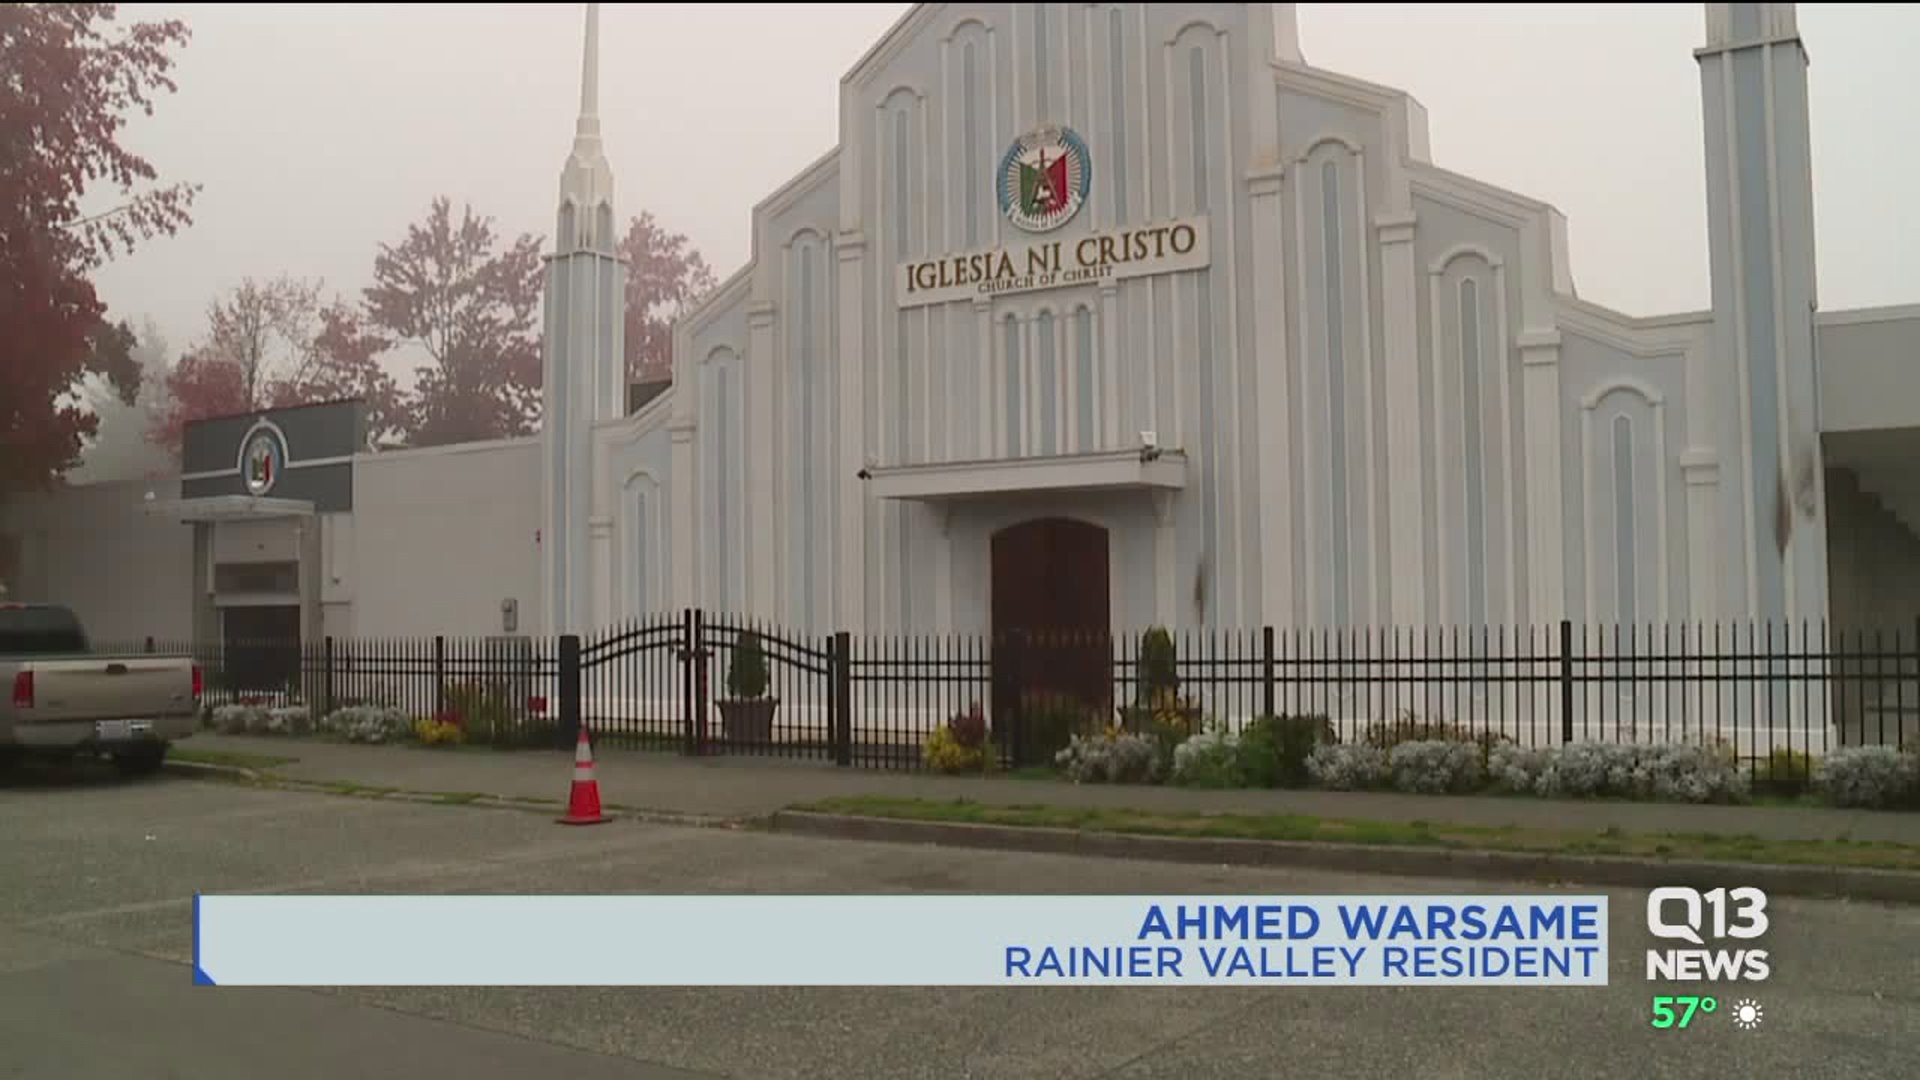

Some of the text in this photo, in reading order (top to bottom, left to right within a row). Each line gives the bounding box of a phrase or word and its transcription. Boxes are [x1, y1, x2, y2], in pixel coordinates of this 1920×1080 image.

[906, 224, 1197, 293] IGLESIA NI CRISTO
[977, 265, 1113, 294] CHURCH OF CHRIST
